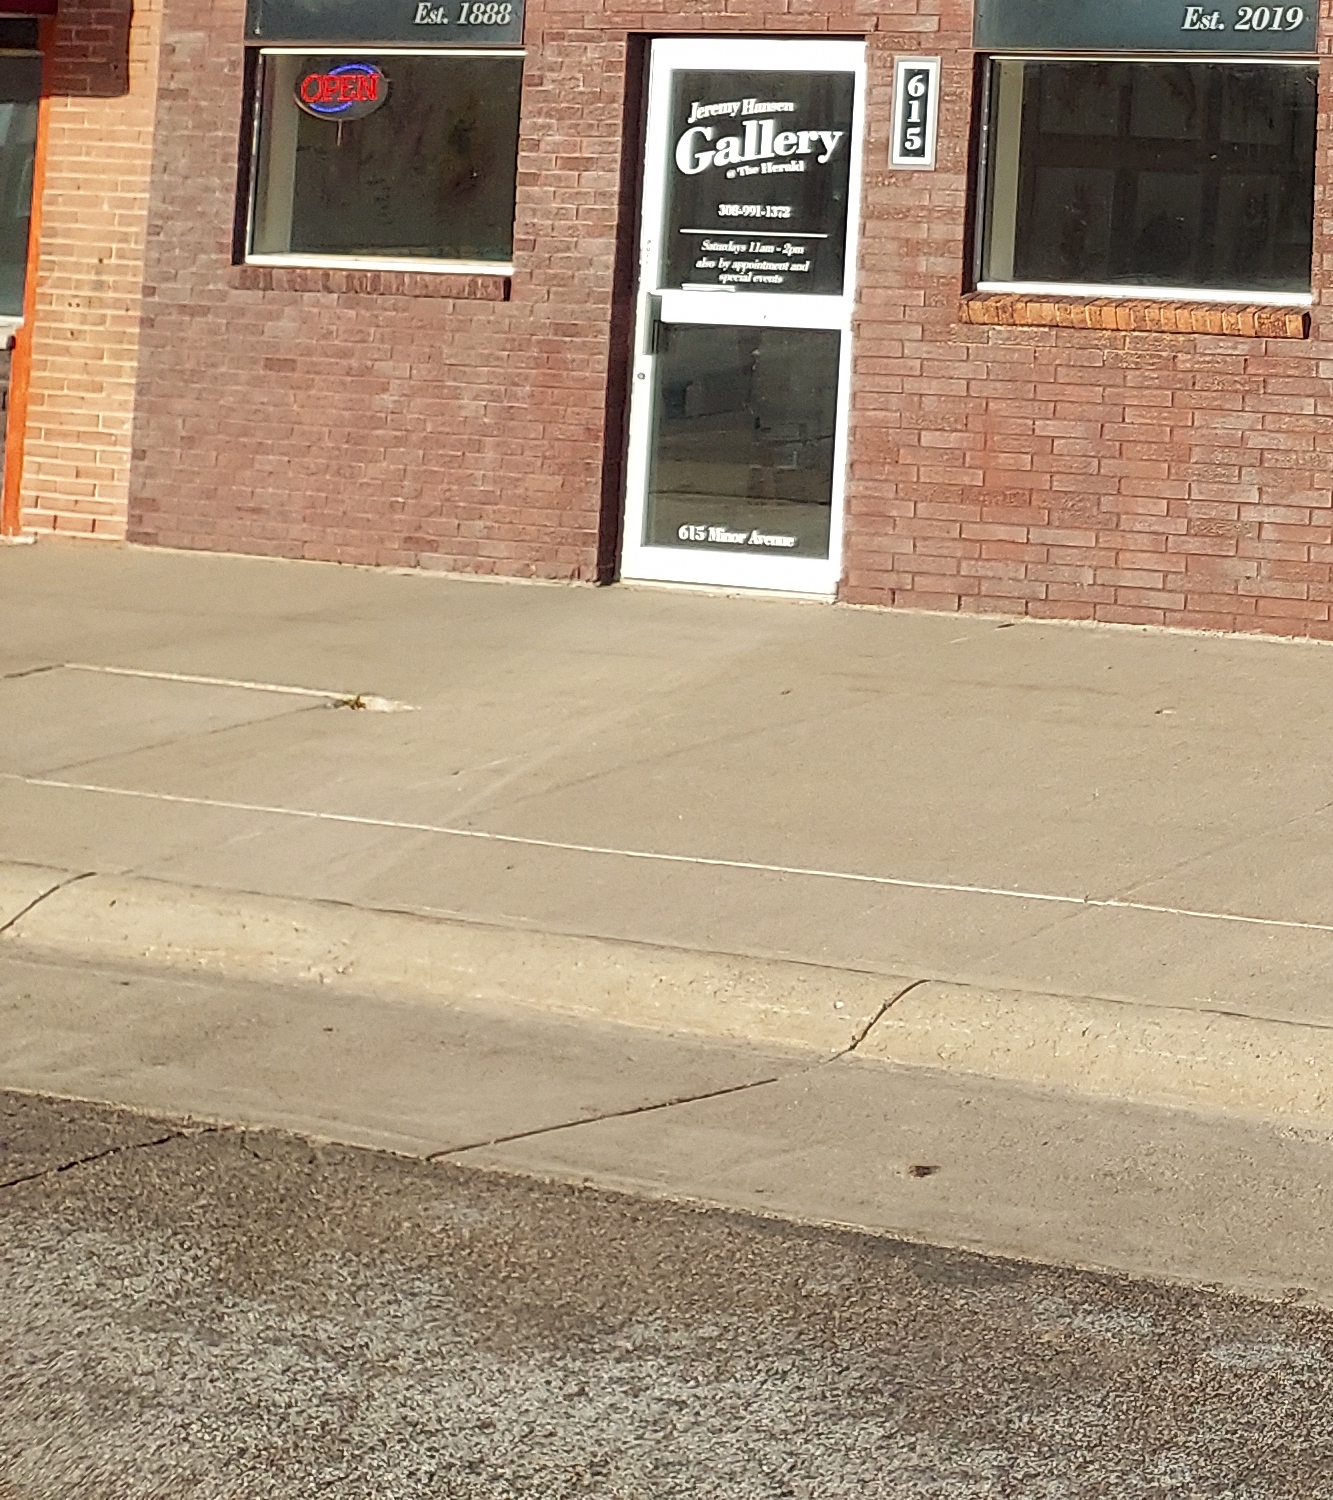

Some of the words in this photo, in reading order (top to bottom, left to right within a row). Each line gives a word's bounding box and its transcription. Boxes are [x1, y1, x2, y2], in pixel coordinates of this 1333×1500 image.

[413, 2, 448, 24] Est.
[456, 2, 512, 25] 1888
[1181, 6, 1224, 30] Est.
[1234, 6, 1303, 31] 2019
[301, 73, 379, 102] OPEN
[687, 101, 741, 123] Jeremy
[741, 99, 794, 115] Hansen
[904, 74, 925, 150] 615
[675, 119, 843, 175] Gallery
[737, 166, 760, 176] The
[718, 204, 791, 218] 308-991-1372
[701, 239, 746, 254] Saturdays
[782, 243, 805, 256] 2pm
[696, 257, 716, 268] also
[718, 258, 729, 271] by
[732, 259, 789, 273] appointment
[790, 261, 810, 272] and
[719, 272, 751, 283] special
[752, 275, 783, 283] events
[678, 525, 705, 540] 615
[707, 527, 747, 544] Minor
[747, 530, 795, 547] Avenue
